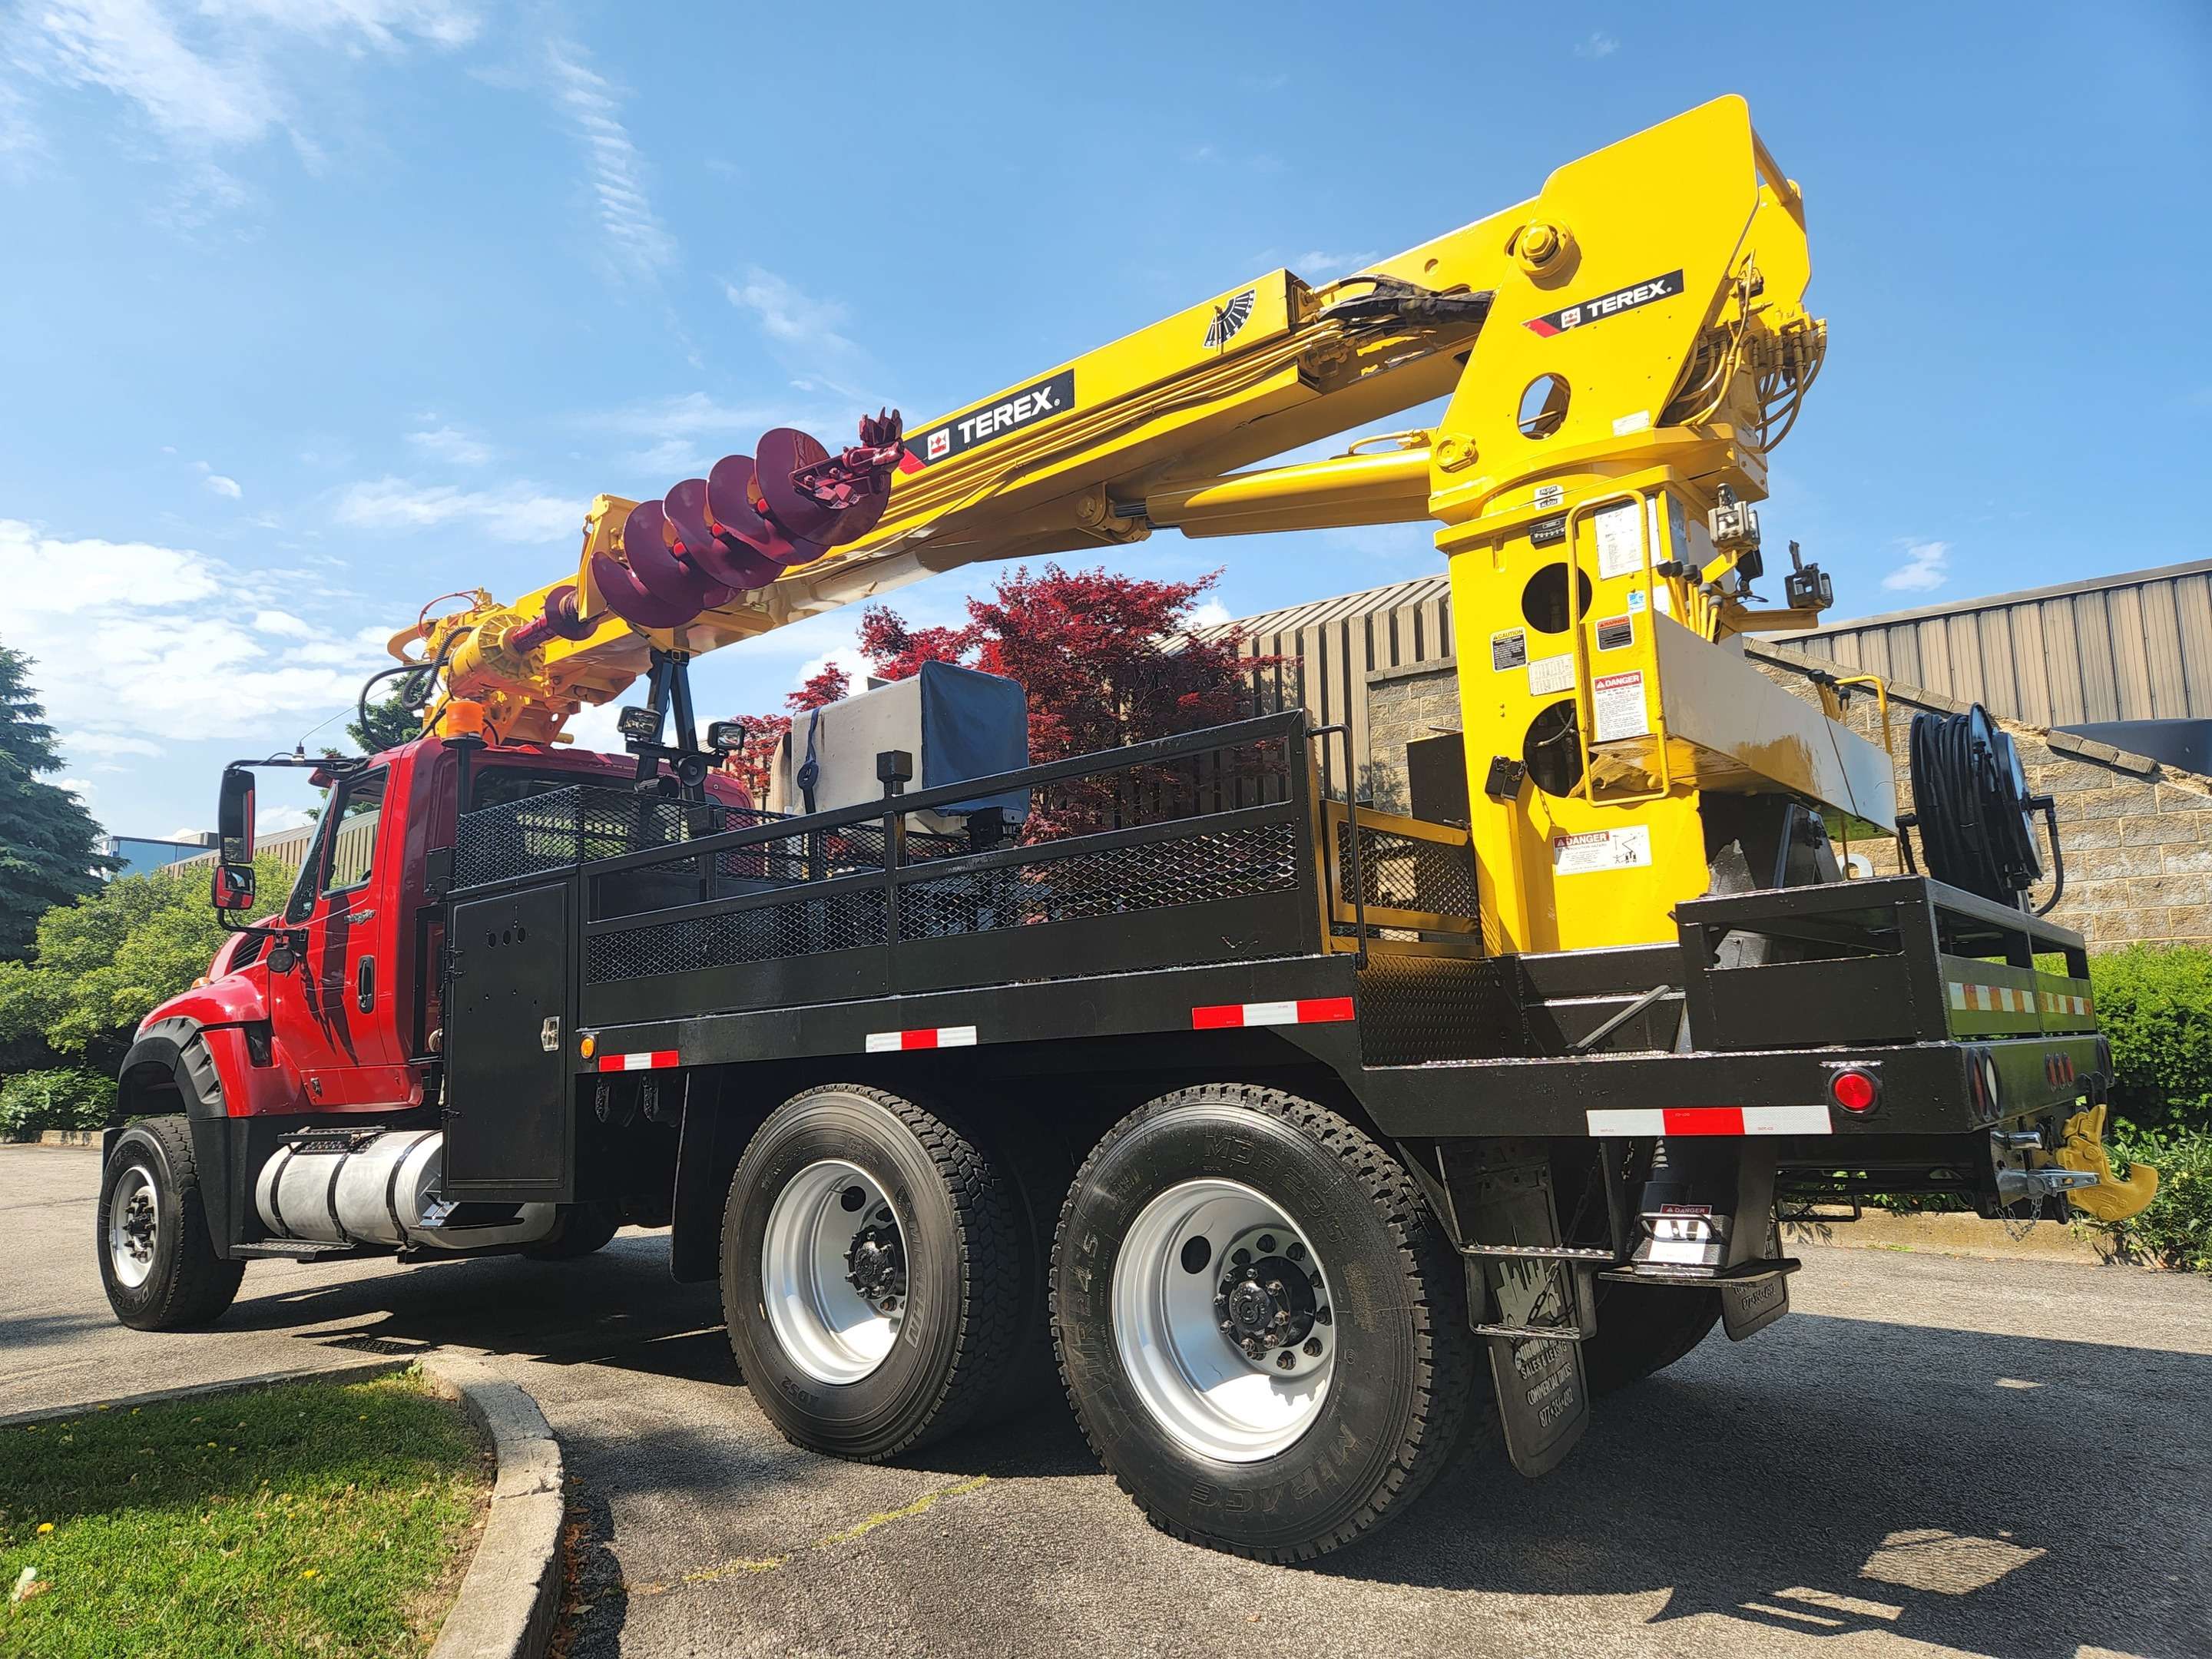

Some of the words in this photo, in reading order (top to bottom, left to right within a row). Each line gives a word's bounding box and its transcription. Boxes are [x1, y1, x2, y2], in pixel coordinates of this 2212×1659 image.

[1587, 280, 1667, 317] TEREX
[958, 386, 1053, 444] TEREX
[1498, 628, 1523, 639] CAUTION
[1604, 674, 1640, 687] DANGER
[1566, 833, 1607, 846] DANGER
[1520, 1357, 1543, 1380] SALES
[1526, 1372, 1560, 1406] COMMERCIAL
